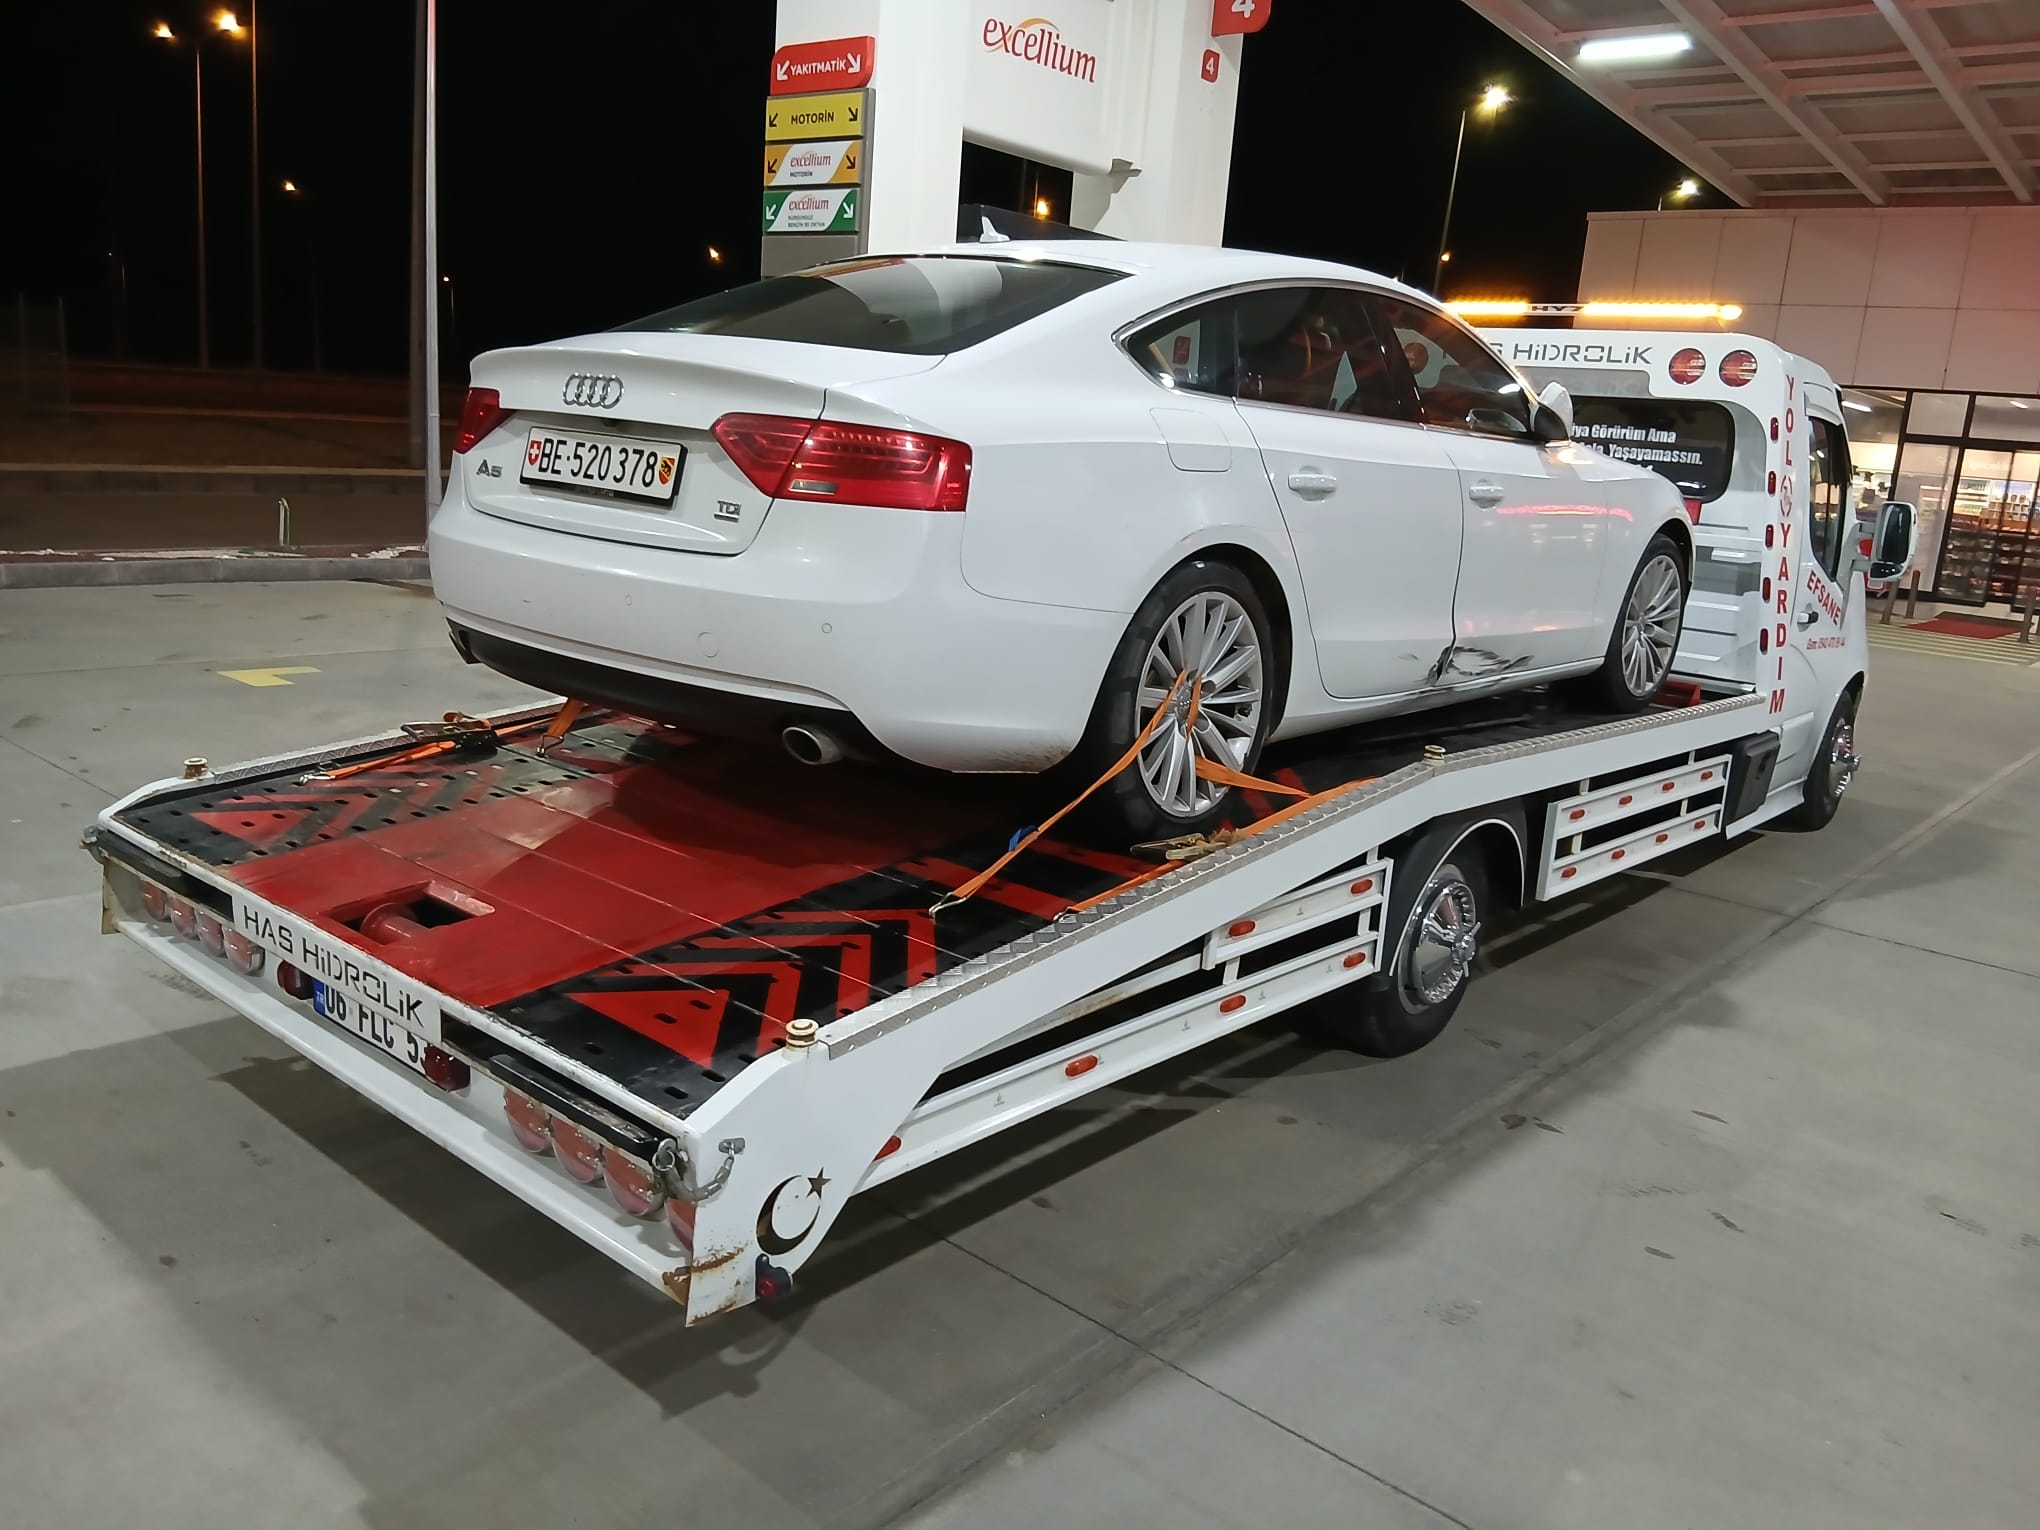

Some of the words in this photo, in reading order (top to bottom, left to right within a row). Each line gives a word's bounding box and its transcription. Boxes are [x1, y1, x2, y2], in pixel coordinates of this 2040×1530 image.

[1231, 0, 1255, 18] 4
[983, 18, 1095, 83] excellium
[790, 58, 846, 76] YAKITMATİK
[1205, 57, 1215, 75] 4
[791, 109, 835, 125] MOTORİN
[790, 153, 831, 168] excellium
[788, 197, 829, 211] excellium
[1784, 374, 1795, 466] YOL
[1591, 424, 1646, 442] Görürüm
[1647, 427, 1677, 443] Ama
[1608, 443, 1703, 465] Yaşayamassın.
[476, 458, 503, 478] A5
[717, 500, 742, 516] TDI
[1806, 569, 1842, 626] EFSANE
[1769, 523, 1792, 714] YARDIM
[244, 905, 293, 954] HAS
[325, 983, 346, 1021] 06
